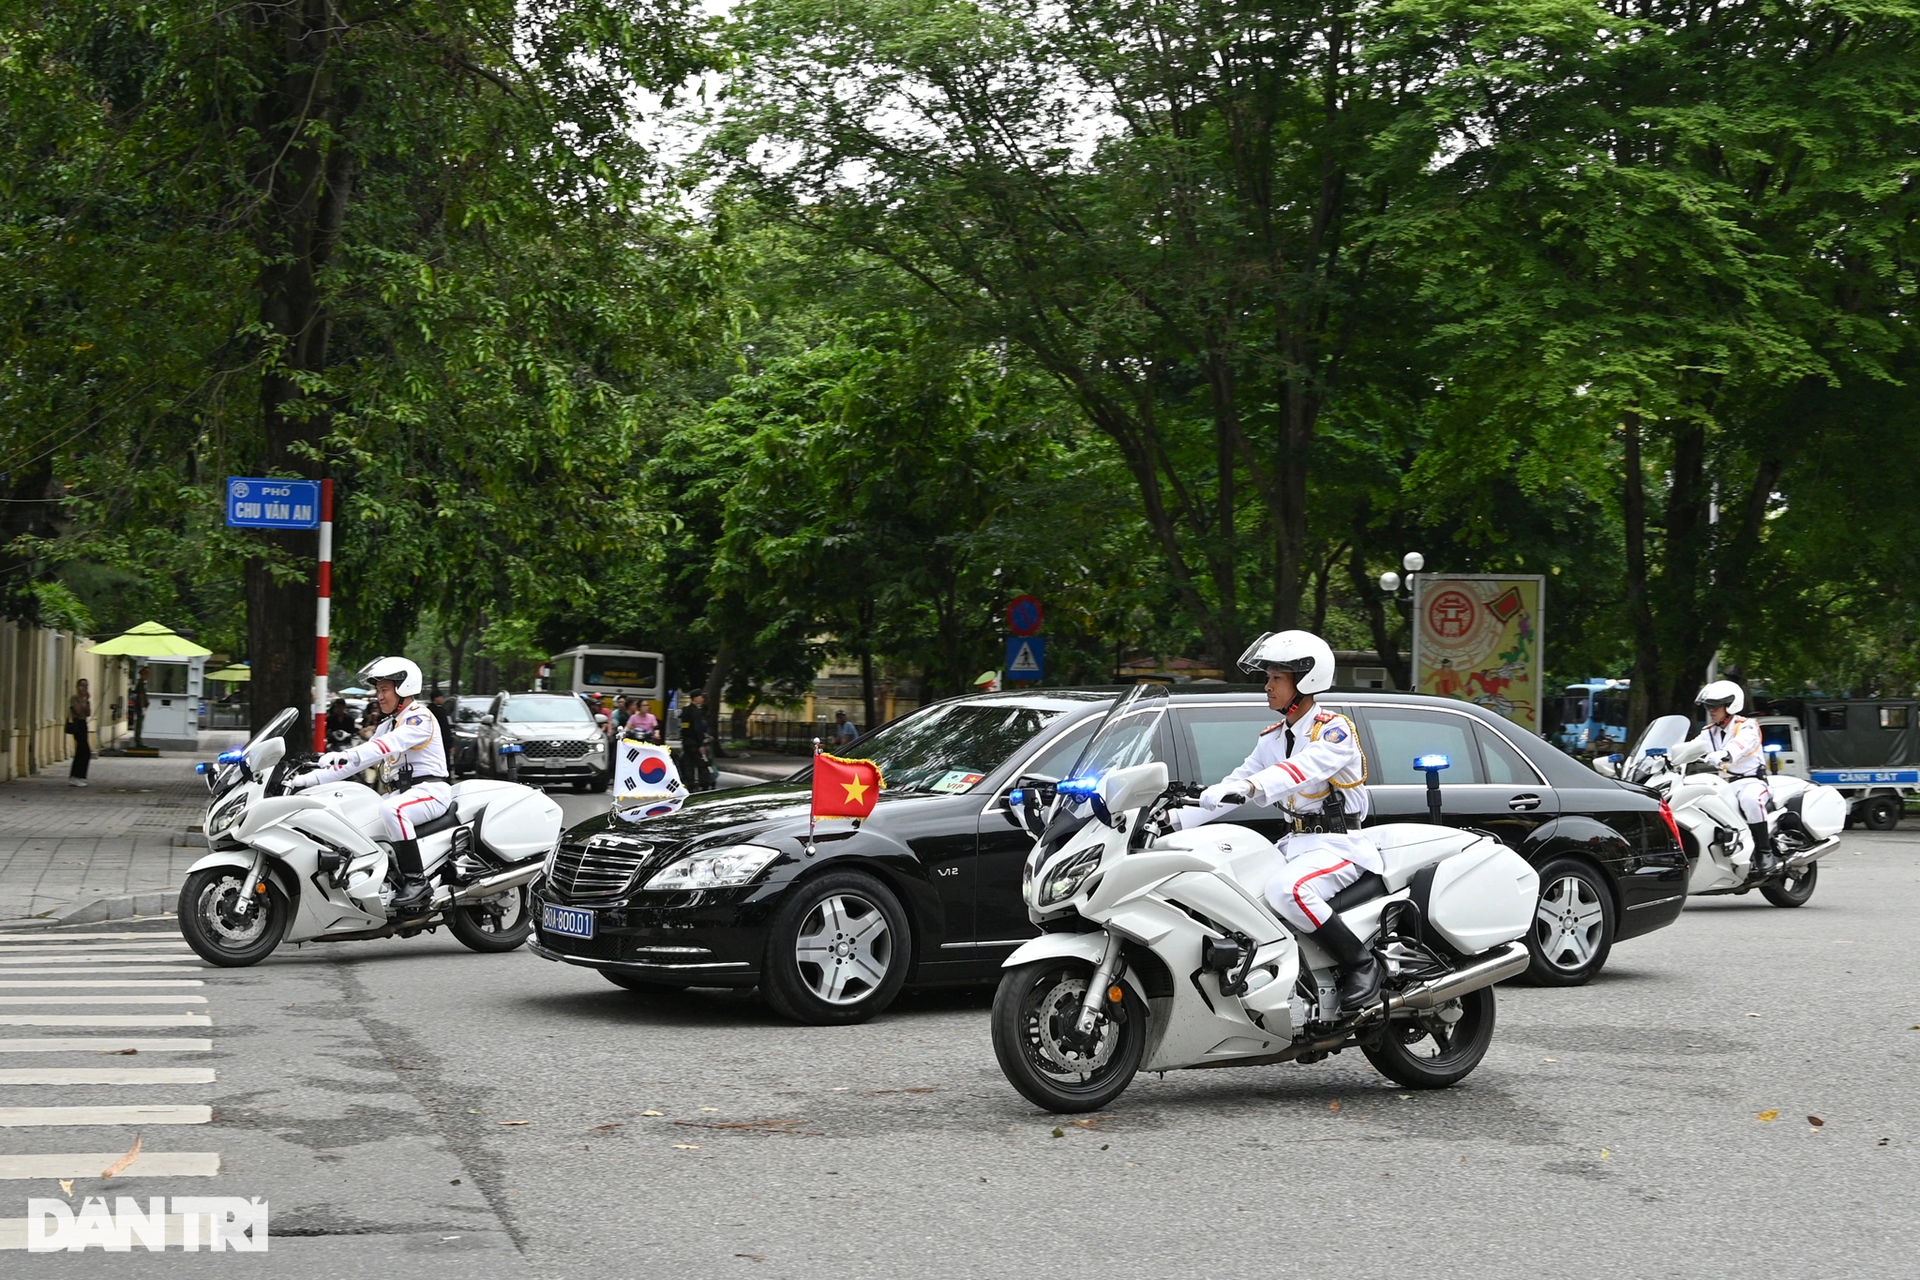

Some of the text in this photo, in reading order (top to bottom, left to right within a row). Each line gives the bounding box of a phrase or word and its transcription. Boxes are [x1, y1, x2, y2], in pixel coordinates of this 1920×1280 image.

[262, 484, 292, 497] PHỐ
[235, 500, 312, 521] CHU VĂN AN
[946, 782, 965, 790] VIP
[937, 867, 959, 877] V12
